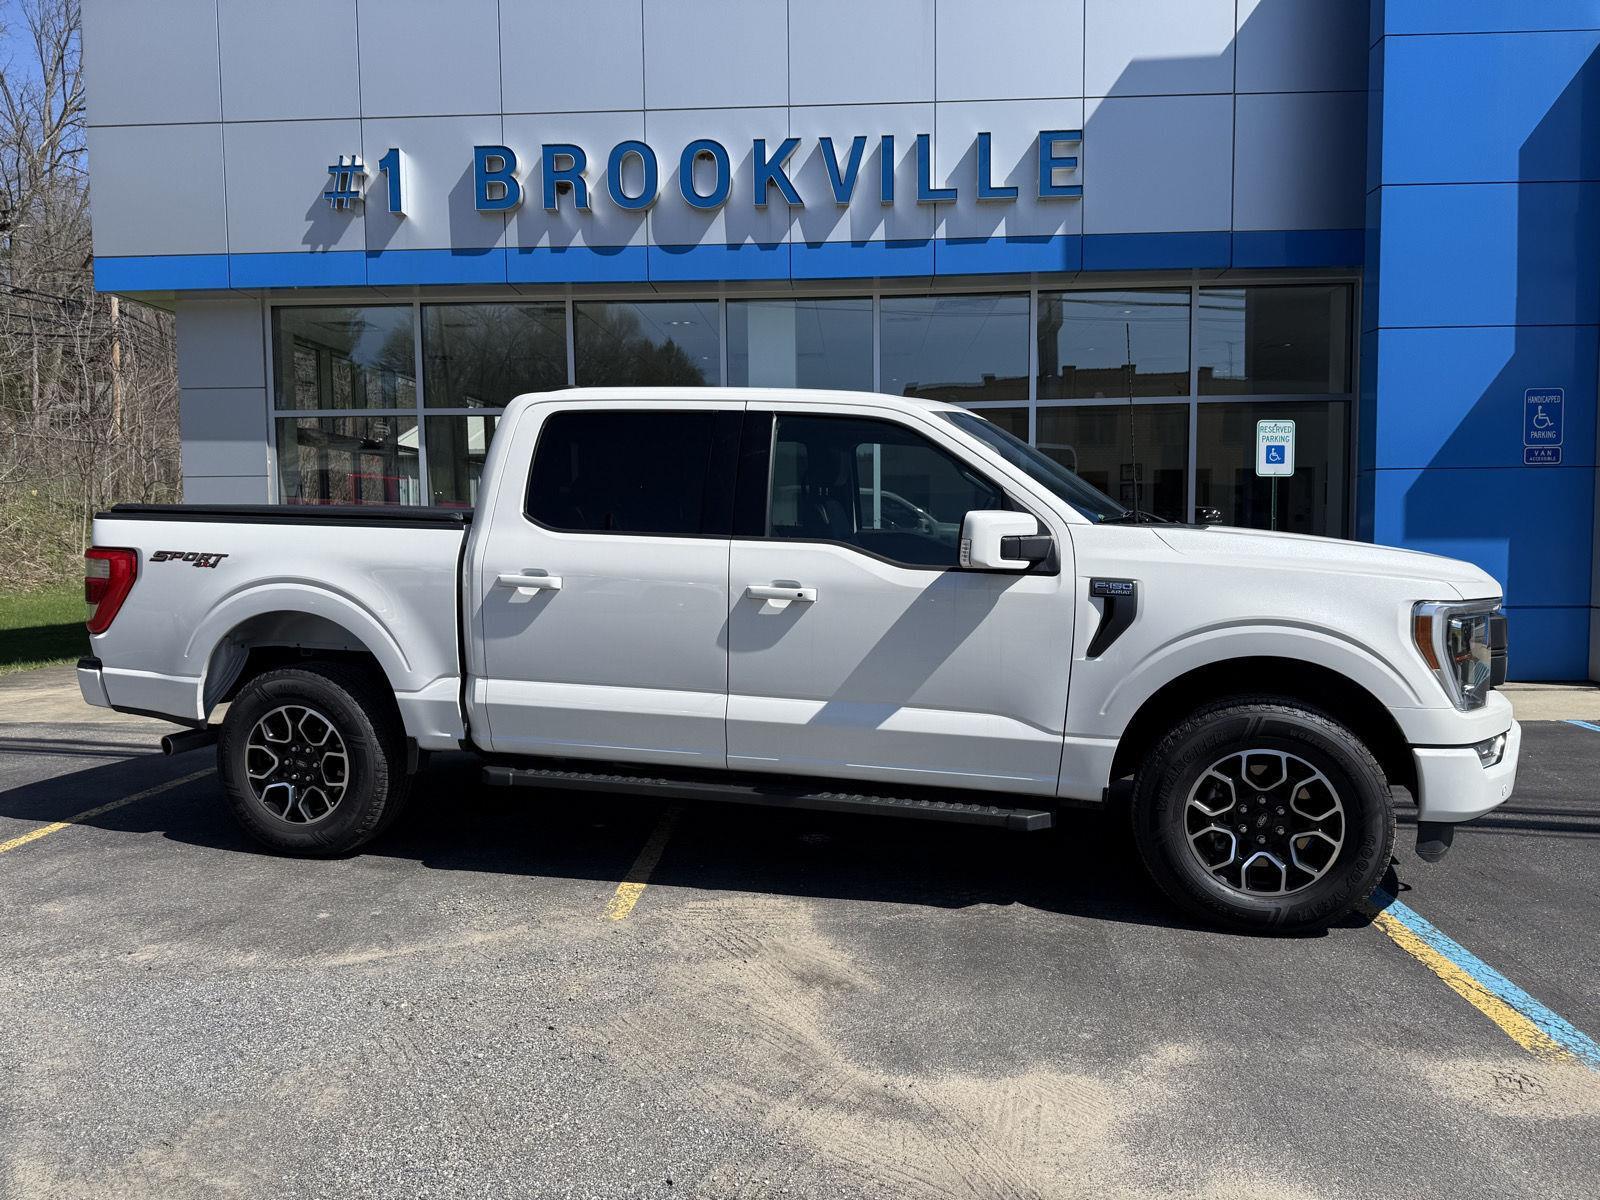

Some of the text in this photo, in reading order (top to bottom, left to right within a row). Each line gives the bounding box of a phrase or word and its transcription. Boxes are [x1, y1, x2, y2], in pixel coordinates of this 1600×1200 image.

[322, 129, 1084, 215] #1 BROOKVILLE
[1527, 395, 1561, 404] HANDICAPPED
[1259, 425, 1292, 434] RESERVED
[1261, 435, 1290, 443] PARKING
[1530, 430, 1557, 439] PARKING
[149, 550, 229, 568] SPORT
[1095, 581, 1133, 589] F-150
[1297, 833, 1376, 921] GOODYEAR
